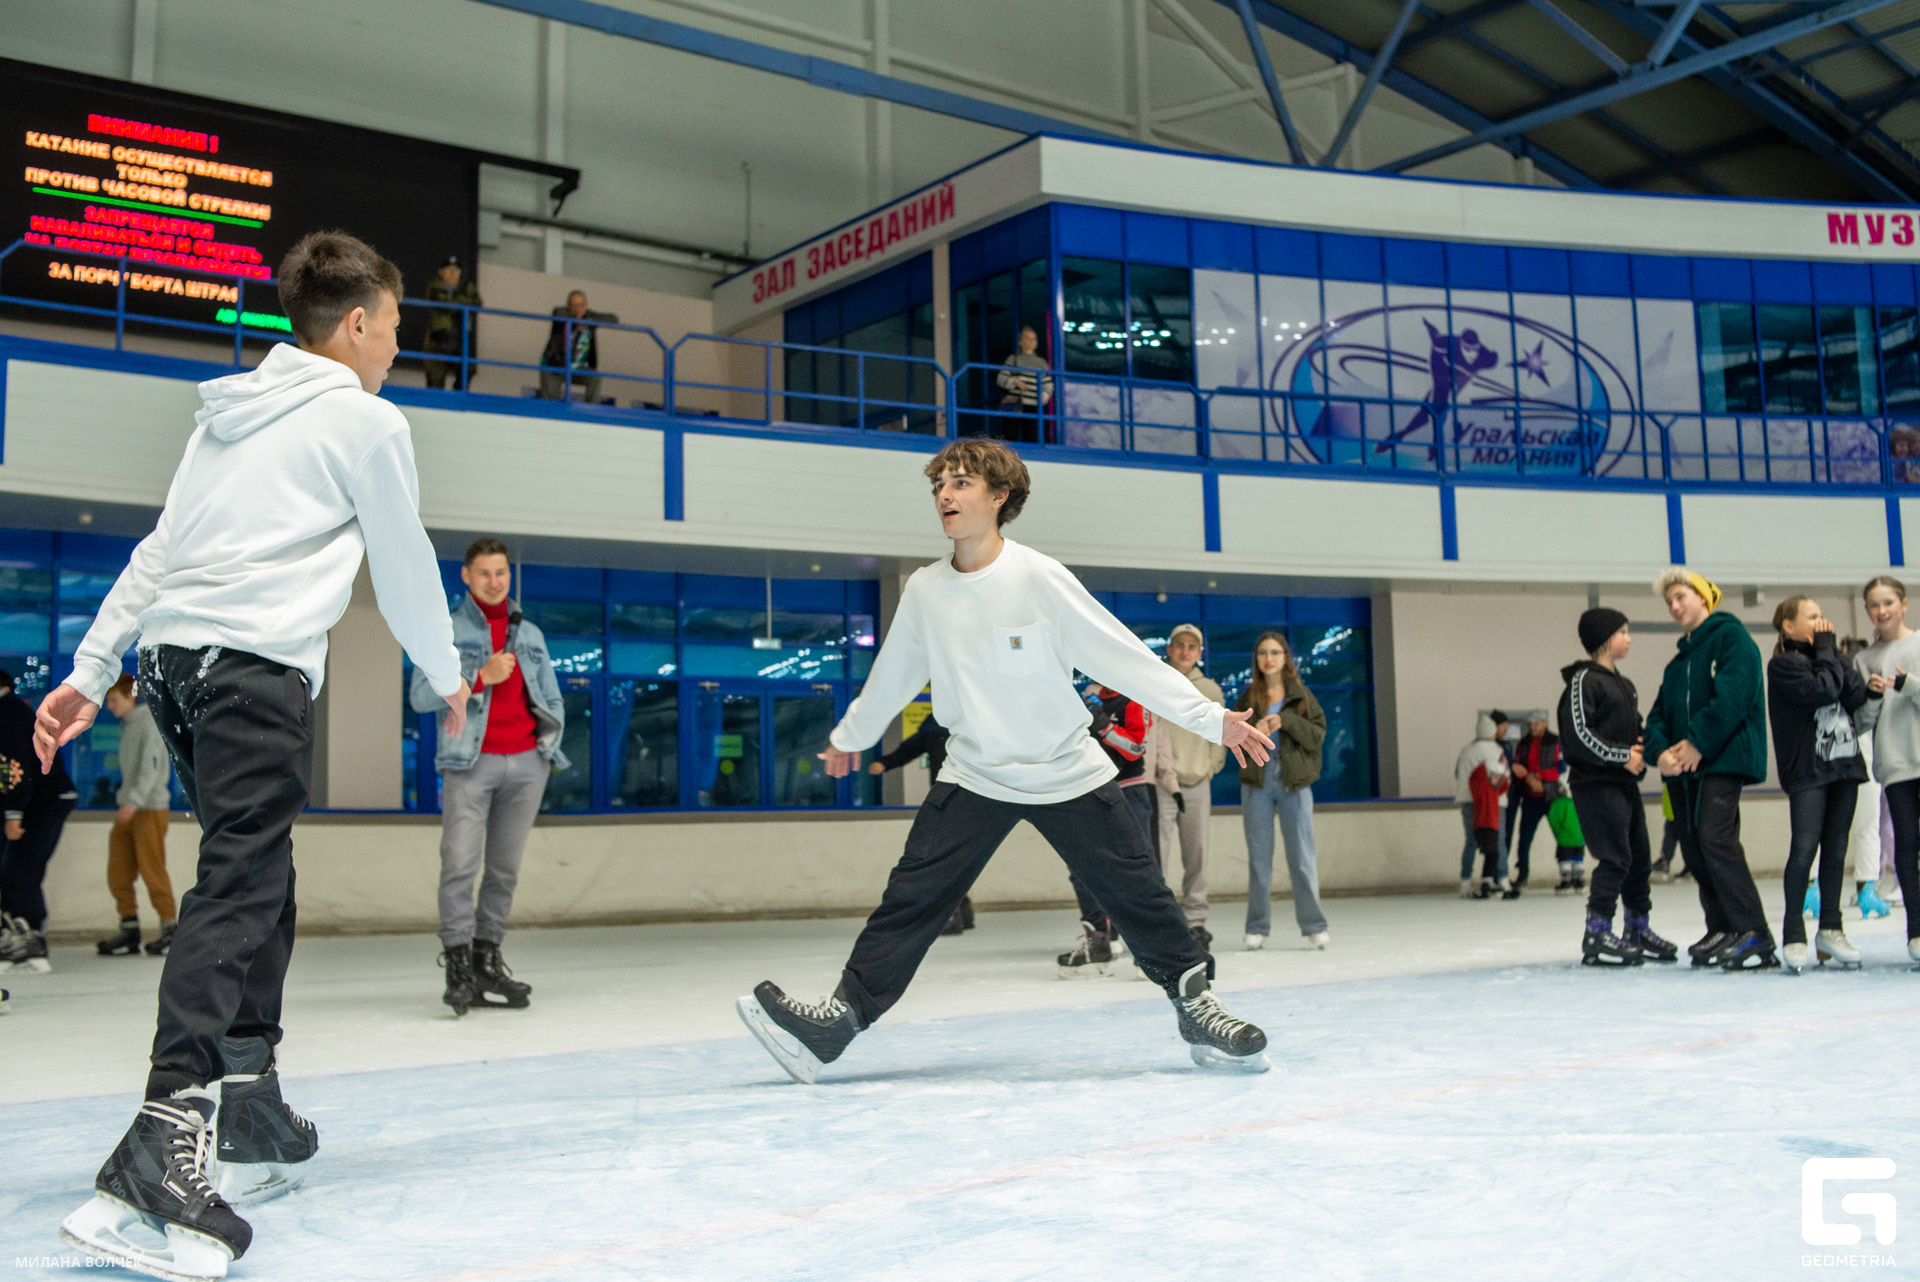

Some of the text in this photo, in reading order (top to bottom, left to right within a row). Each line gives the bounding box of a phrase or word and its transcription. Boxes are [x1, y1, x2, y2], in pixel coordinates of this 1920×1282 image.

[87, 113, 208, 152] ВНИМАНИЕ
[25, 131, 273, 188] КАТАНИЕ ОСУЩЕСТВЛЯЕТСЯ
[116, 163, 188, 189] ТОЛЬКО
[25, 166, 99, 193] ПРОТИВ
[102, 178, 187, 208] ЧАСОВОЙ
[30, 215, 263, 264] НАВАЛИВАТЬСЯ И СИДЕТЬ
[84, 205, 215, 240] ЗАПРЕЩАЕТСЯ
[752, 178, 956, 304] ЗАЛ ЗАСЕДАНИЙ
[1826, 211, 1920, 247] МУЗ
[48, 261, 73, 280] ЗА
[130, 272, 185, 296] БОРТА
